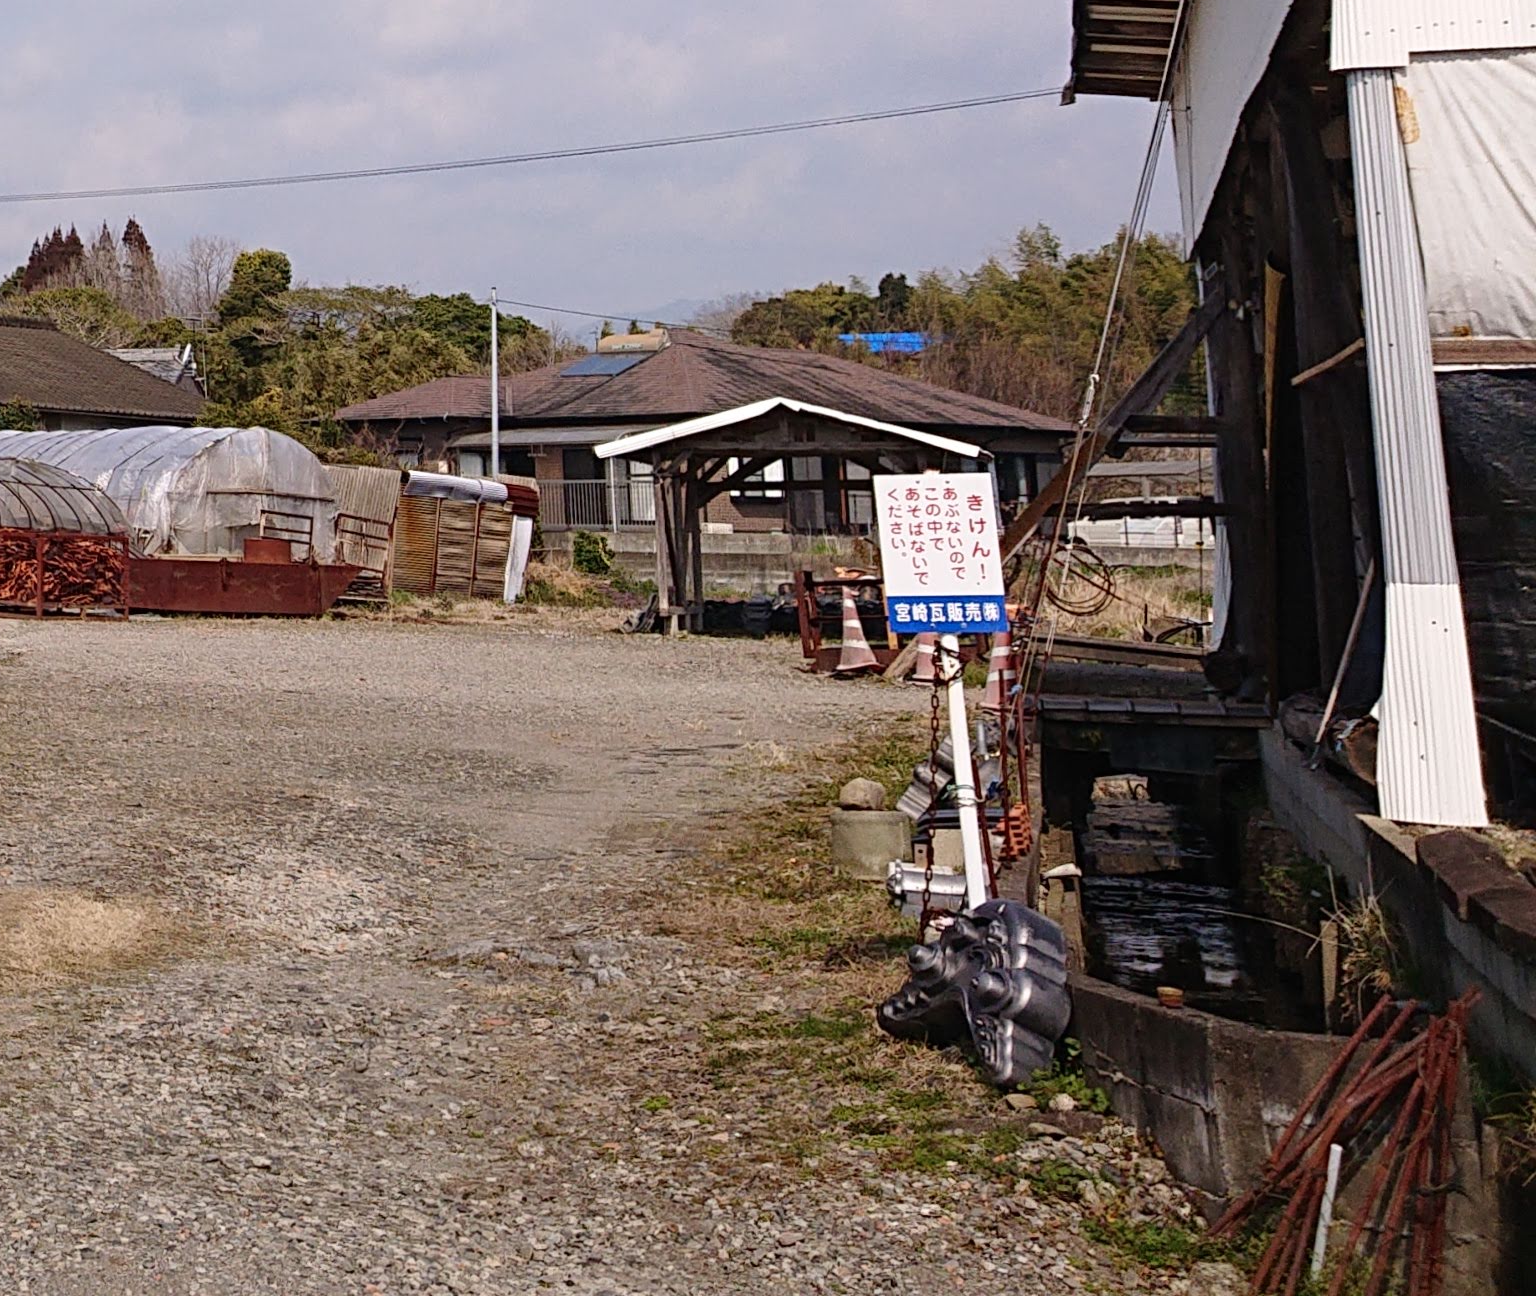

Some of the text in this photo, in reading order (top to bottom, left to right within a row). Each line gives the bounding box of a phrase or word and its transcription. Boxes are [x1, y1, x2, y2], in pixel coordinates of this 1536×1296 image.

[888, 488, 907, 557] ください。
[905, 488, 928, 585] あそばないで
[925, 488, 944, 551] この中で
[943, 488, 965, 580] あぶないので
